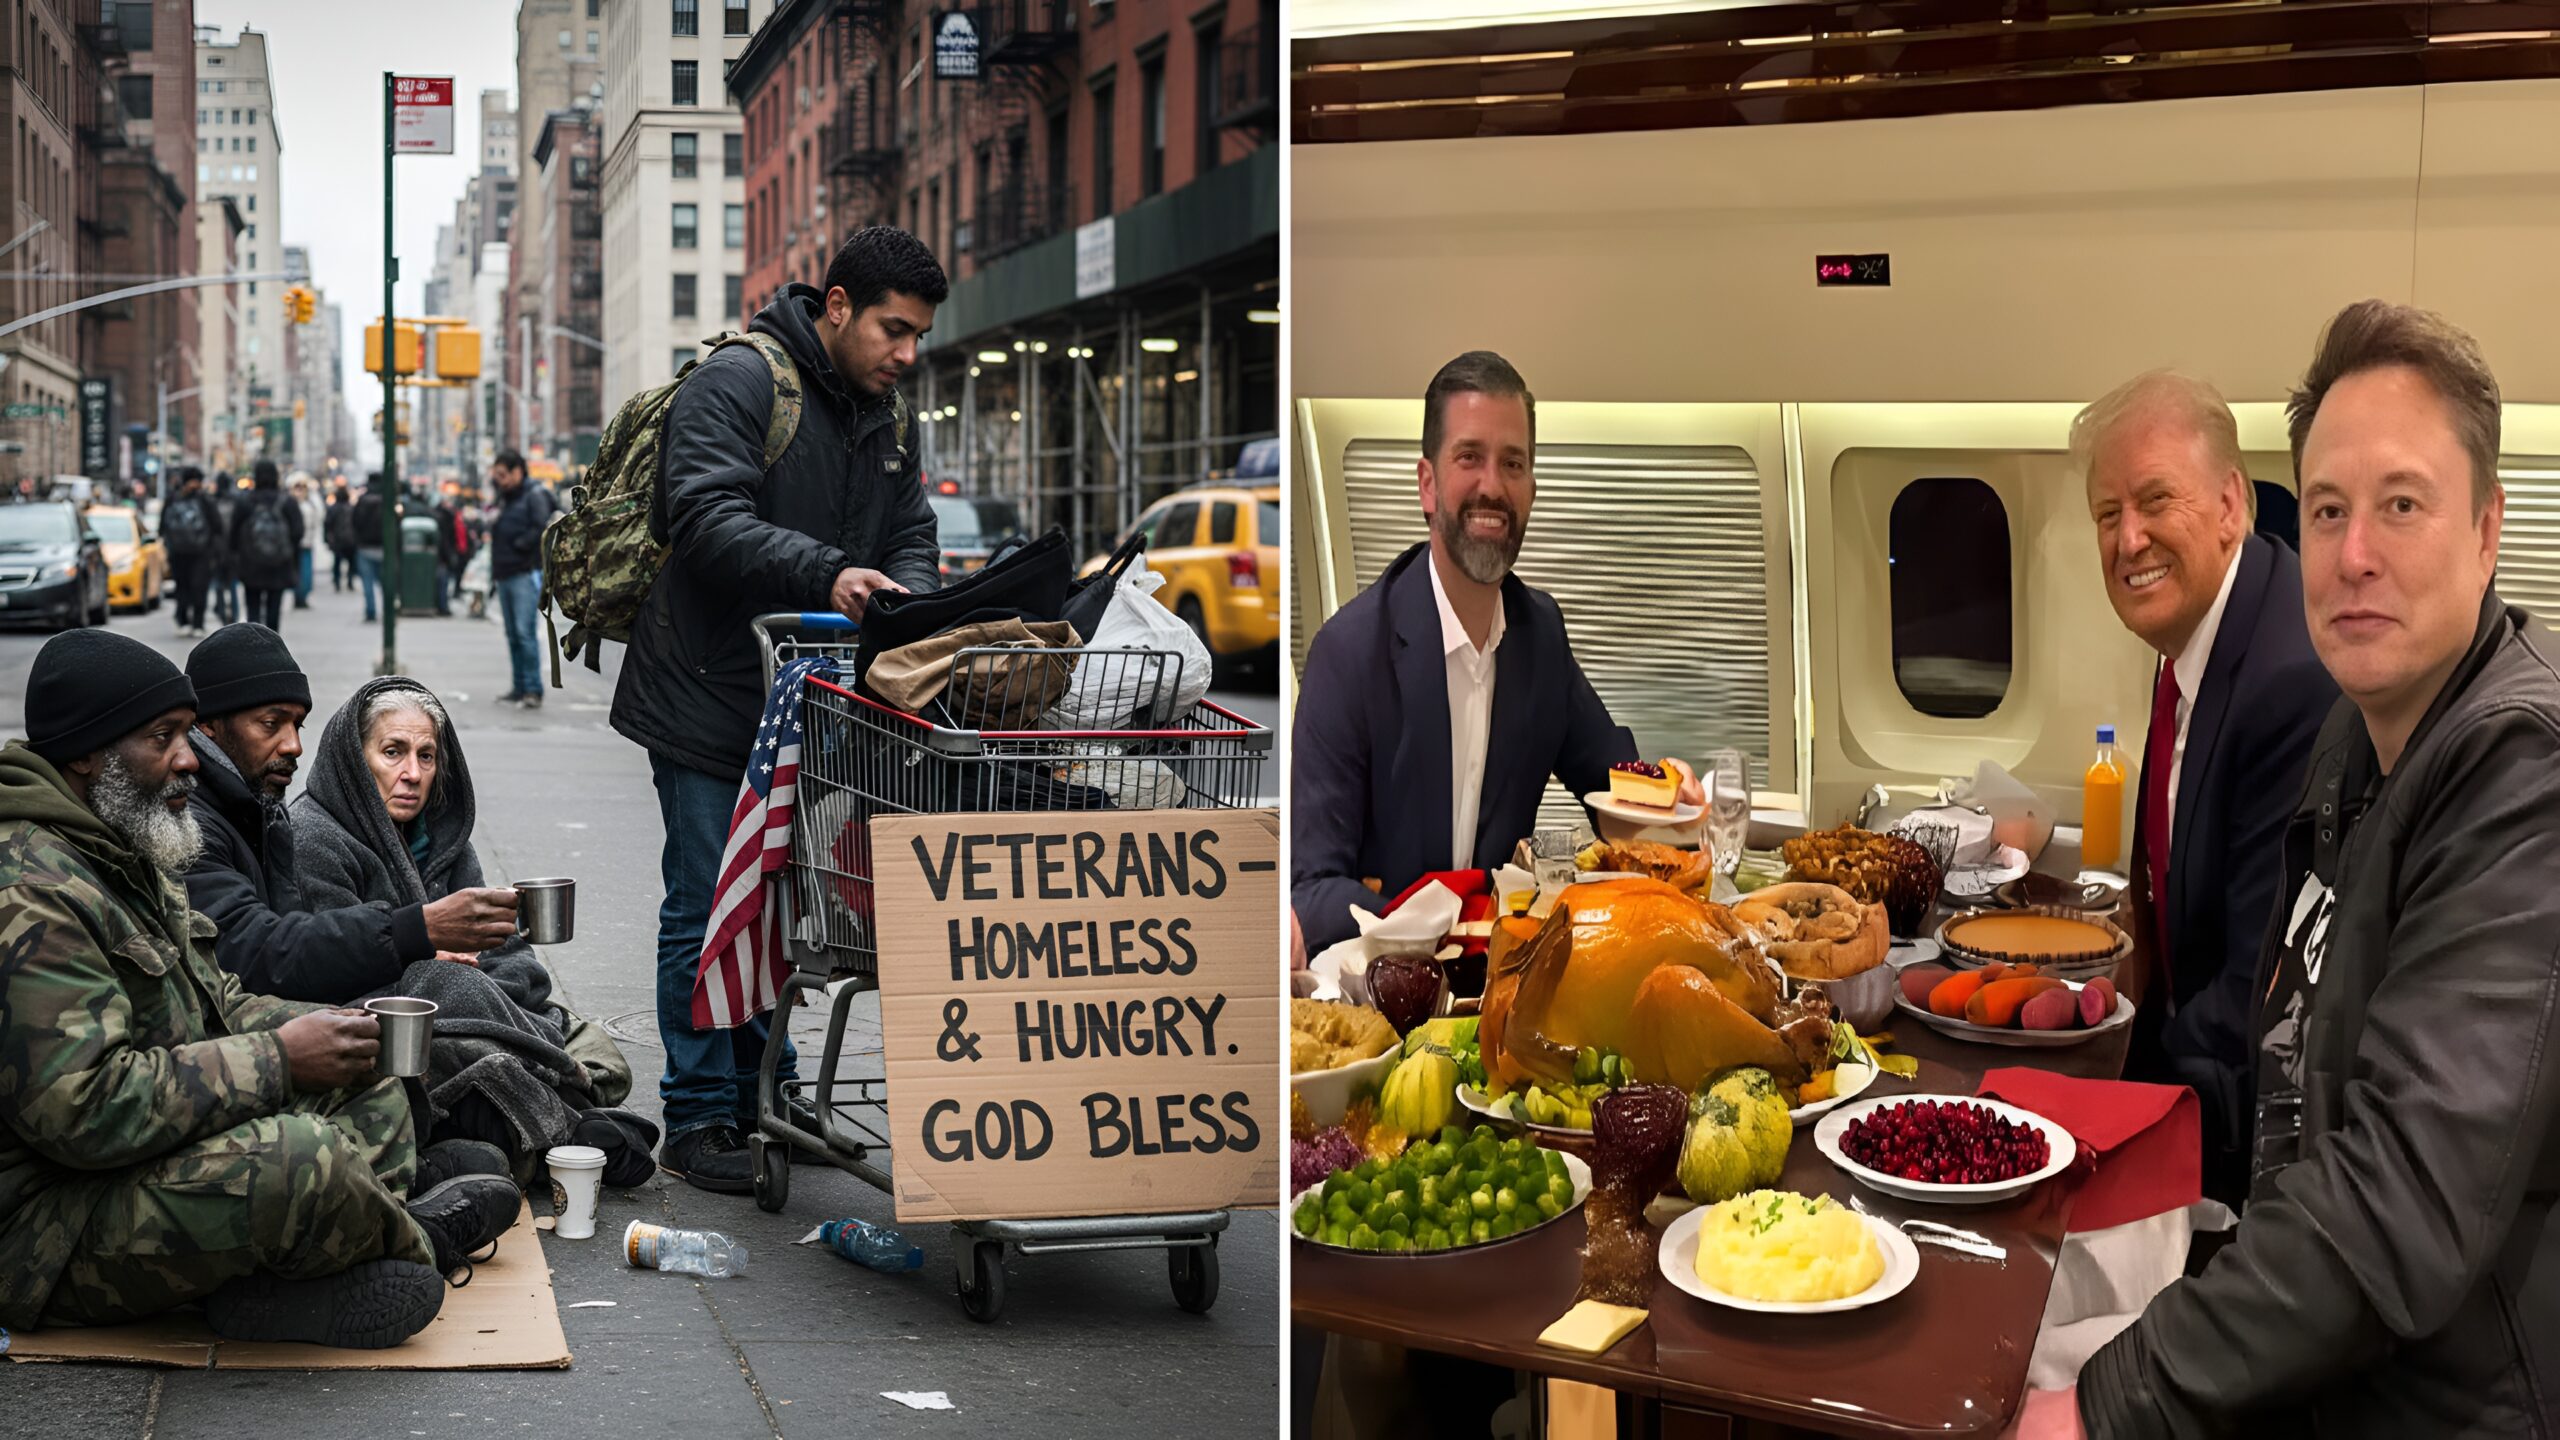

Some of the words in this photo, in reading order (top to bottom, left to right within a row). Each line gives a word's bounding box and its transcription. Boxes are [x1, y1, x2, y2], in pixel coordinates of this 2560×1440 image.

[948, 917, 1197, 980] HOMELESS
[937, 999, 982, 1062] &
[1015, 994, 1238, 1062] HUNGRY.
[922, 1100, 1053, 1162] GOD
[1081, 1091, 1260, 1158] BLESS
